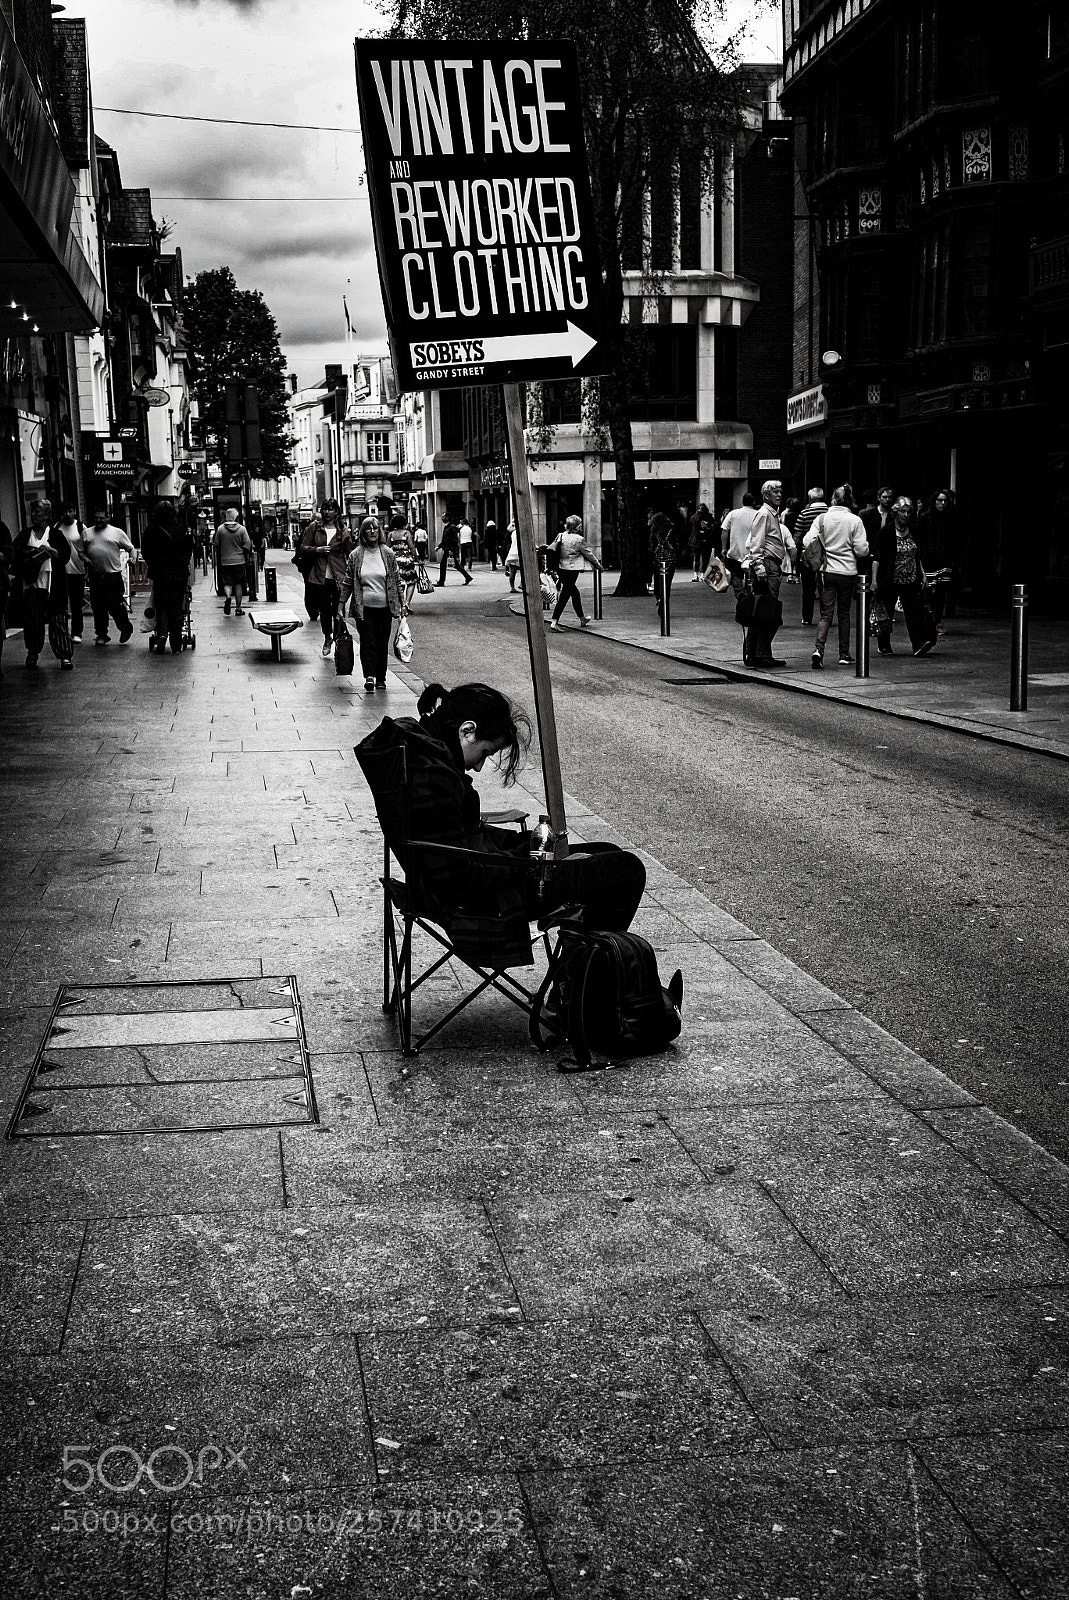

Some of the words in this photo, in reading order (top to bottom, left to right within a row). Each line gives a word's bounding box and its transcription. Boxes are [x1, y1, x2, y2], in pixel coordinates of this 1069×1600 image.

[370, 59, 571, 157] VINTAGE
[390, 160, 411, 179] AND
[390, 177, 581, 250] REWORKED
[402, 245, 589, 320] CLOTHING
[414, 340, 485, 367] SOBEYS
[416, 369, 449, 380] GANDY
[451, 366, 485, 378] STREET
